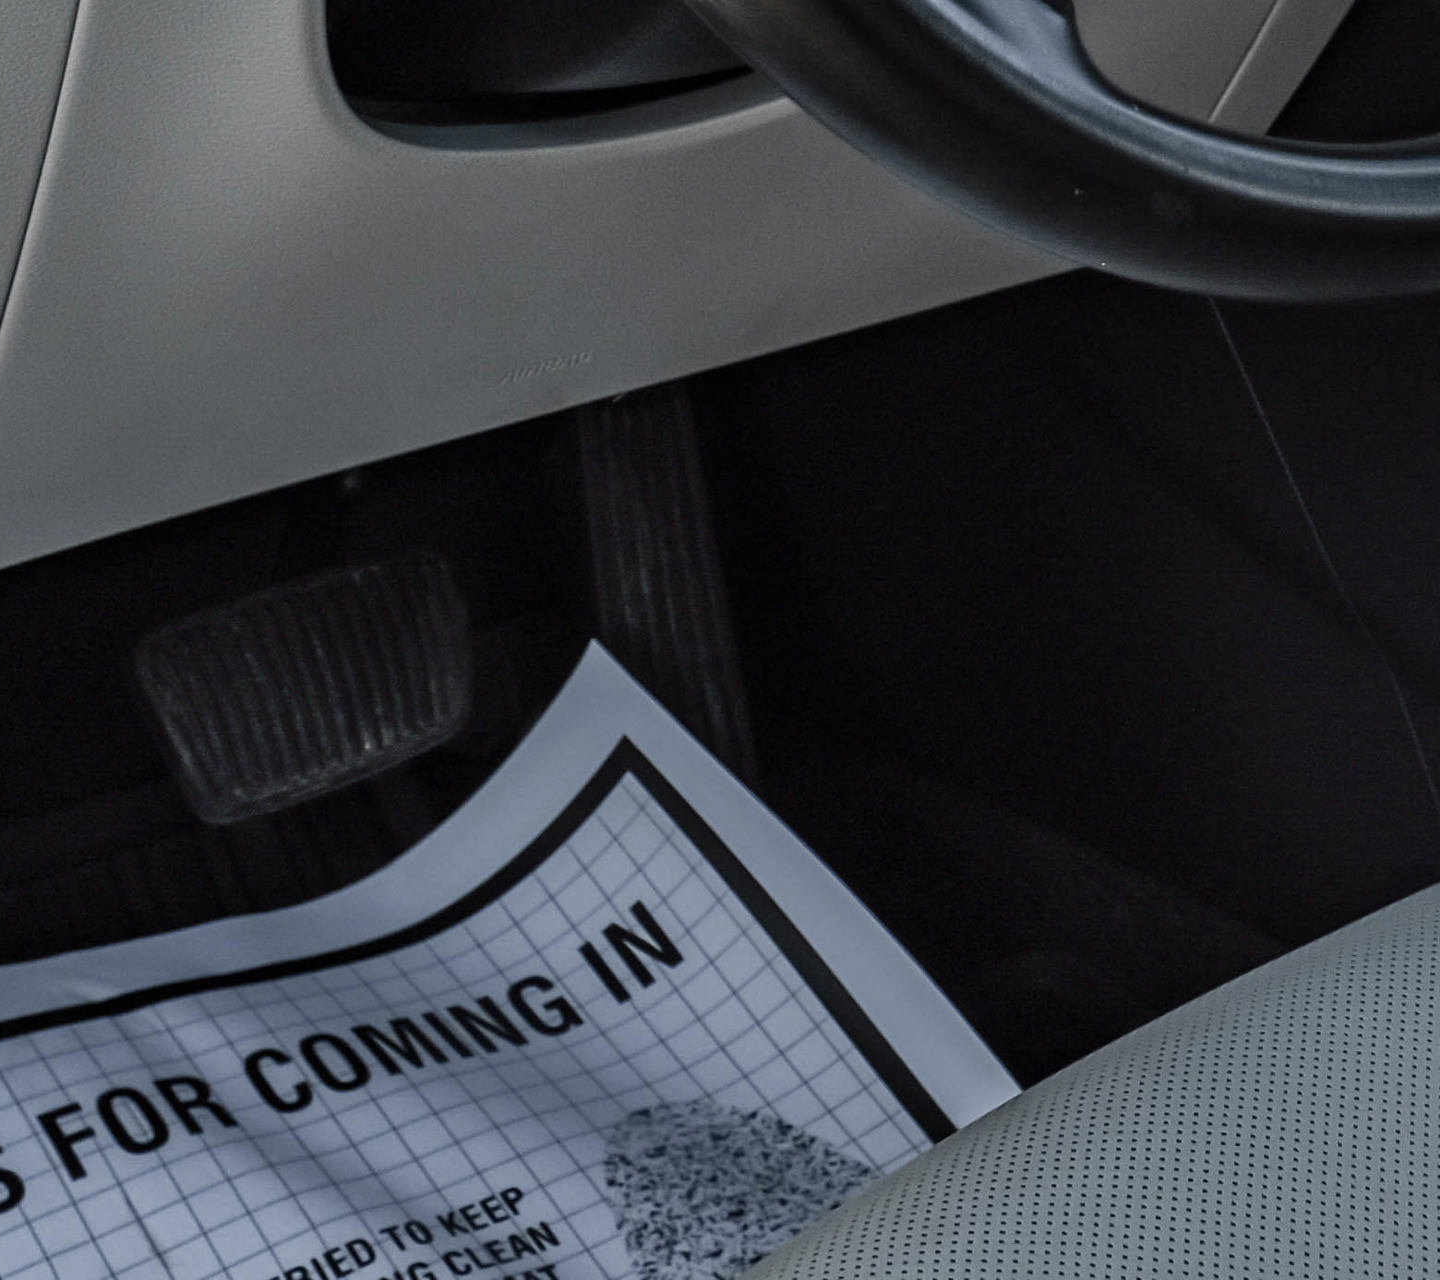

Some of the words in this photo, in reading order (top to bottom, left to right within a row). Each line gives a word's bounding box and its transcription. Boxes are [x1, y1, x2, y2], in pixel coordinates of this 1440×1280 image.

[38, 1074, 238, 1183] FOR
[243, 975, 582, 1116] COMING
[579, 900, 688, 1005] IN
[268, 1237, 377, 1280] RIED
[379, 1220, 435, 1253] TO
[436, 1187, 524, 1237] KEEP
[442, 1221, 561, 1277] CLEAN
